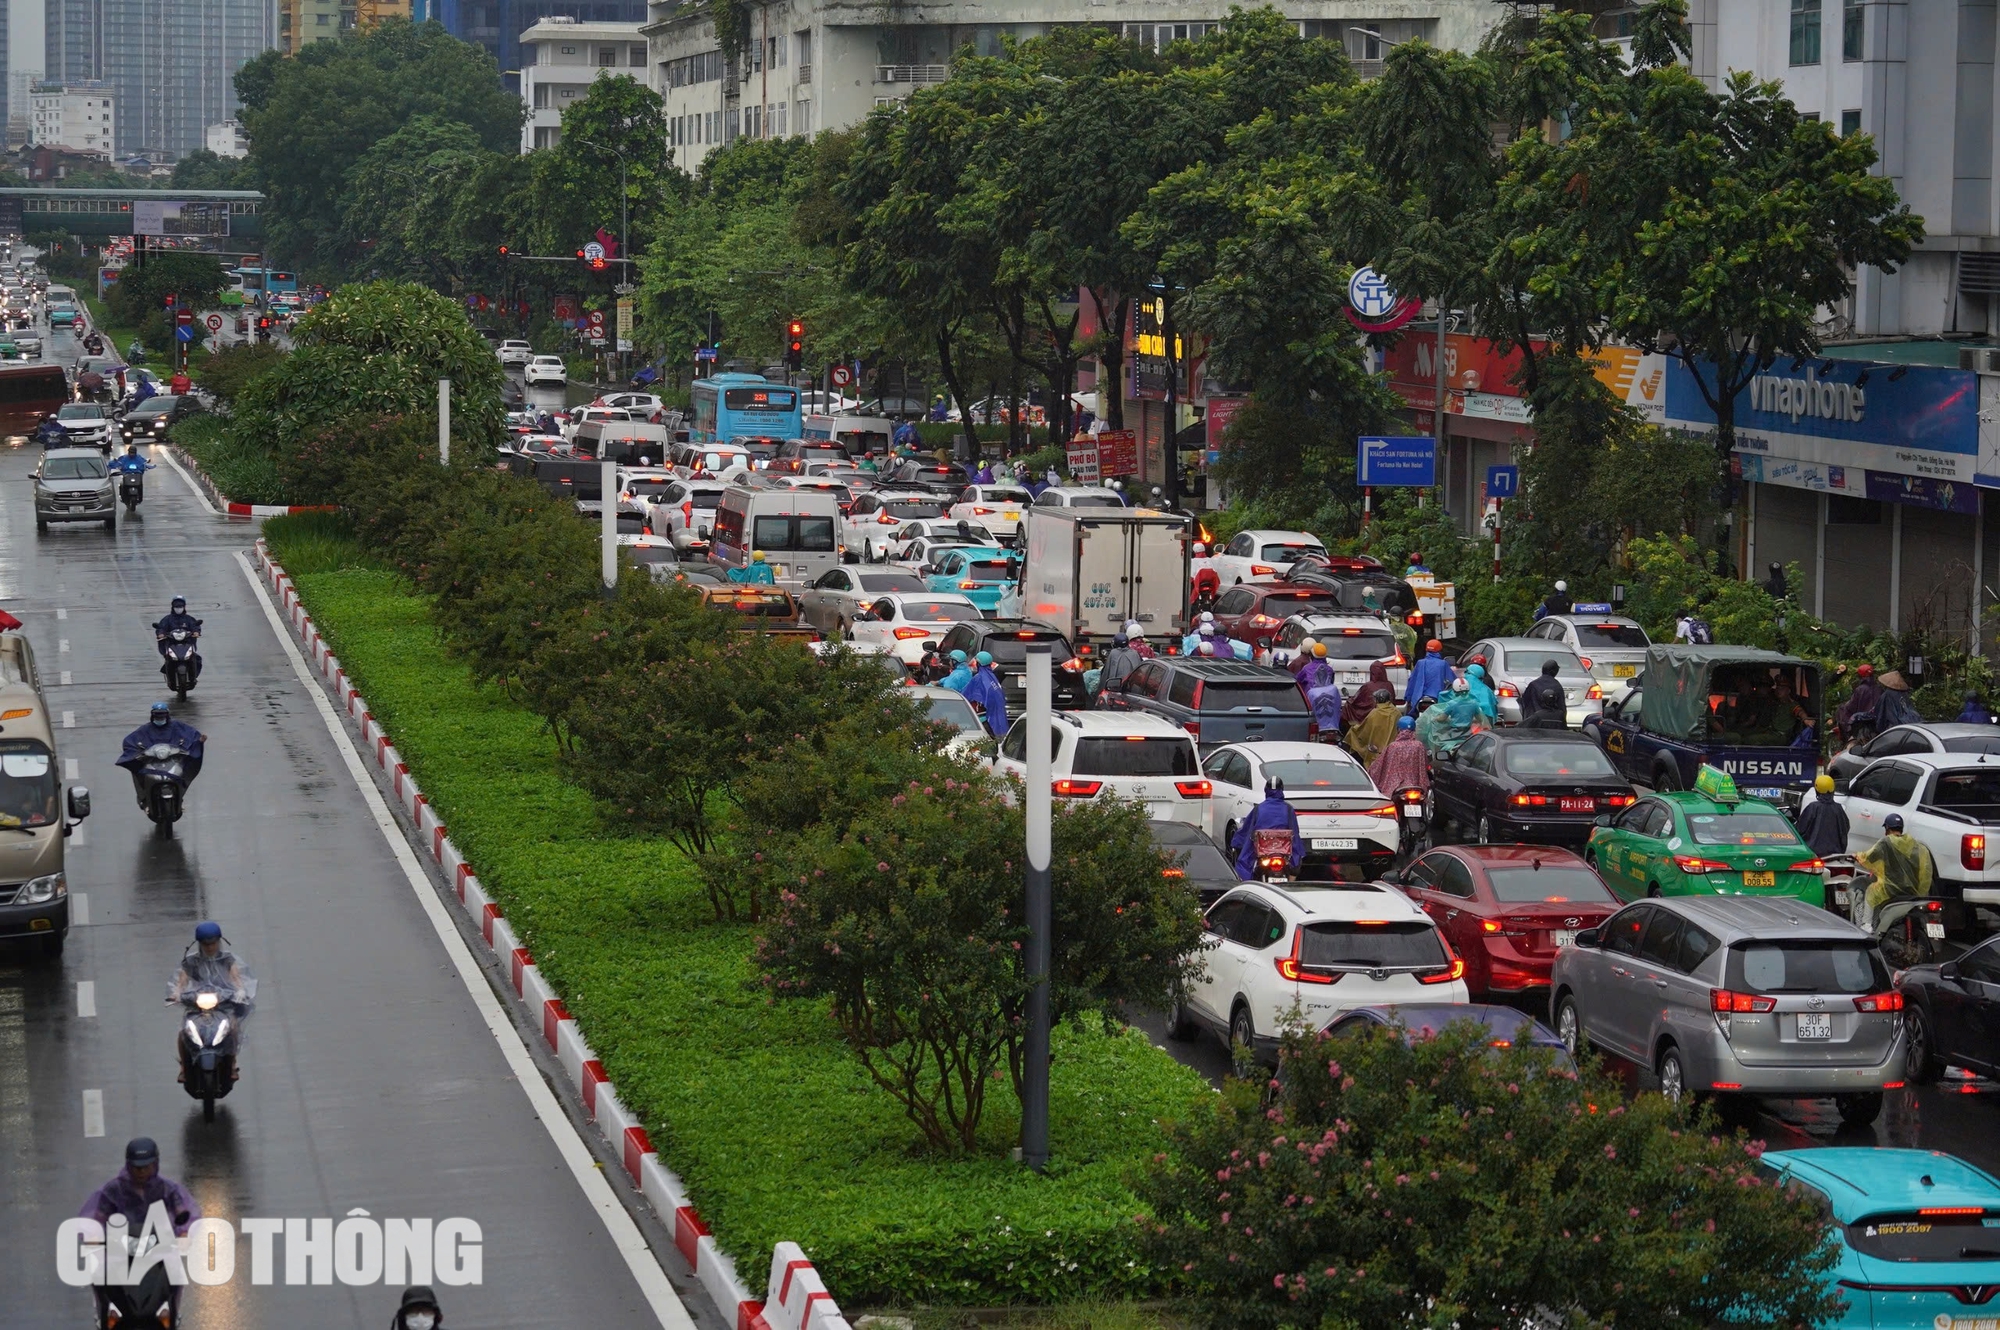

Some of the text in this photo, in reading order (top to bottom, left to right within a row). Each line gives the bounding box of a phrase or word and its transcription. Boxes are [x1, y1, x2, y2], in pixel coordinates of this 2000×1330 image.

[753, 393, 768, 401] 22A
[1723, 760, 1803, 776] NISSAN
[1561, 799, 1594, 809] PA-11-24
[1316, 840, 1354, 848] 18A-442.35
[1805, 1014, 1823, 1026] 30F
[1799, 1026, 1830, 1038] 651.32
[1878, 1224, 1932, 1236] 1900 2097
